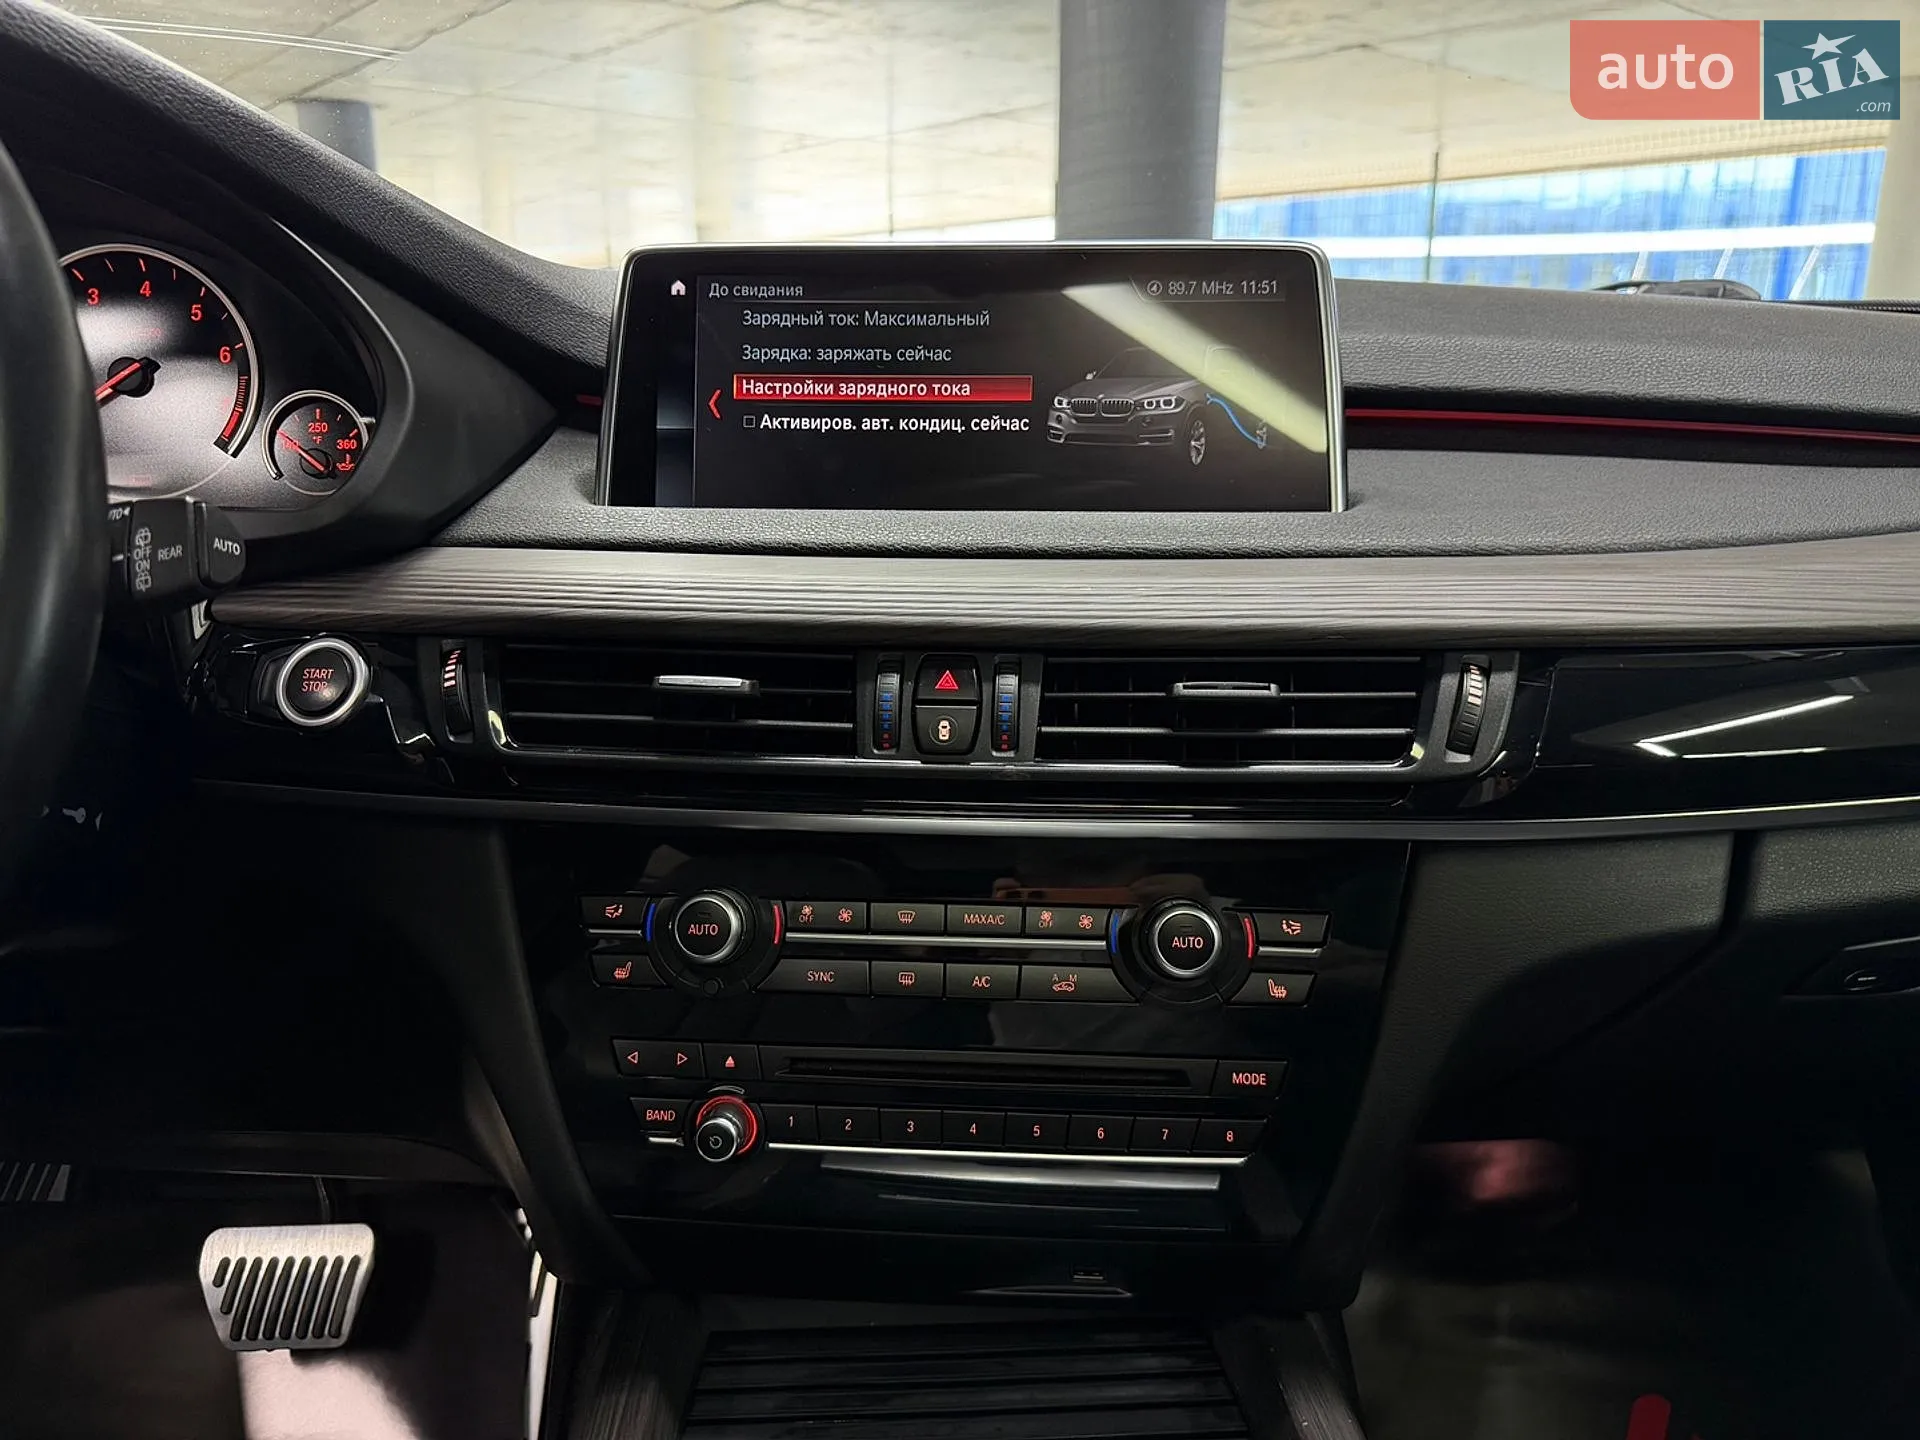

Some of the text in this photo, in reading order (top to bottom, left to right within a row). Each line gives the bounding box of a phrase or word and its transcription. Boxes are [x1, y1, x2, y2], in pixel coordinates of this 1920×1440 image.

[140, 281, 151, 297] 4
[709, 283, 803, 298] До свидания
[1168, 281, 1277, 295] 89.7 MHz 11:51
[87, 289, 99, 304] 3
[191, 305, 202, 321] 5
[743, 311, 990, 328] Зарядный ток: Максимальный
[219, 347, 231, 363] 6
[742, 345, 952, 363] Зарядка: заряжать сейчас
[742, 379, 970, 398] Настройки зарядного тока
[308, 423, 328, 433] 250
[760, 414, 1029, 433] Активиров. авт. кондиц. сейчас
[336, 439, 357, 450] 360
[134, 547, 152, 560] OFF
[158, 545, 183, 561] REAR
[213, 537, 241, 556] AUTO
[136, 560, 151, 572] ON
[303, 669, 334, 679] START
[302, 681, 328, 692] STOP
[799, 914, 814, 923] OFF
[688, 923, 718, 936] AUTO
[1171, 936, 1203, 949] AUTO
[807, 971, 835, 984] SYNC
[973, 975, 990, 988] A/C
[1232, 1072, 1266, 1086] MODE
[646, 1109, 676, 1122] BAND
[788, 1116, 1234, 1142] 1 2 3 4 5 6 7 8
